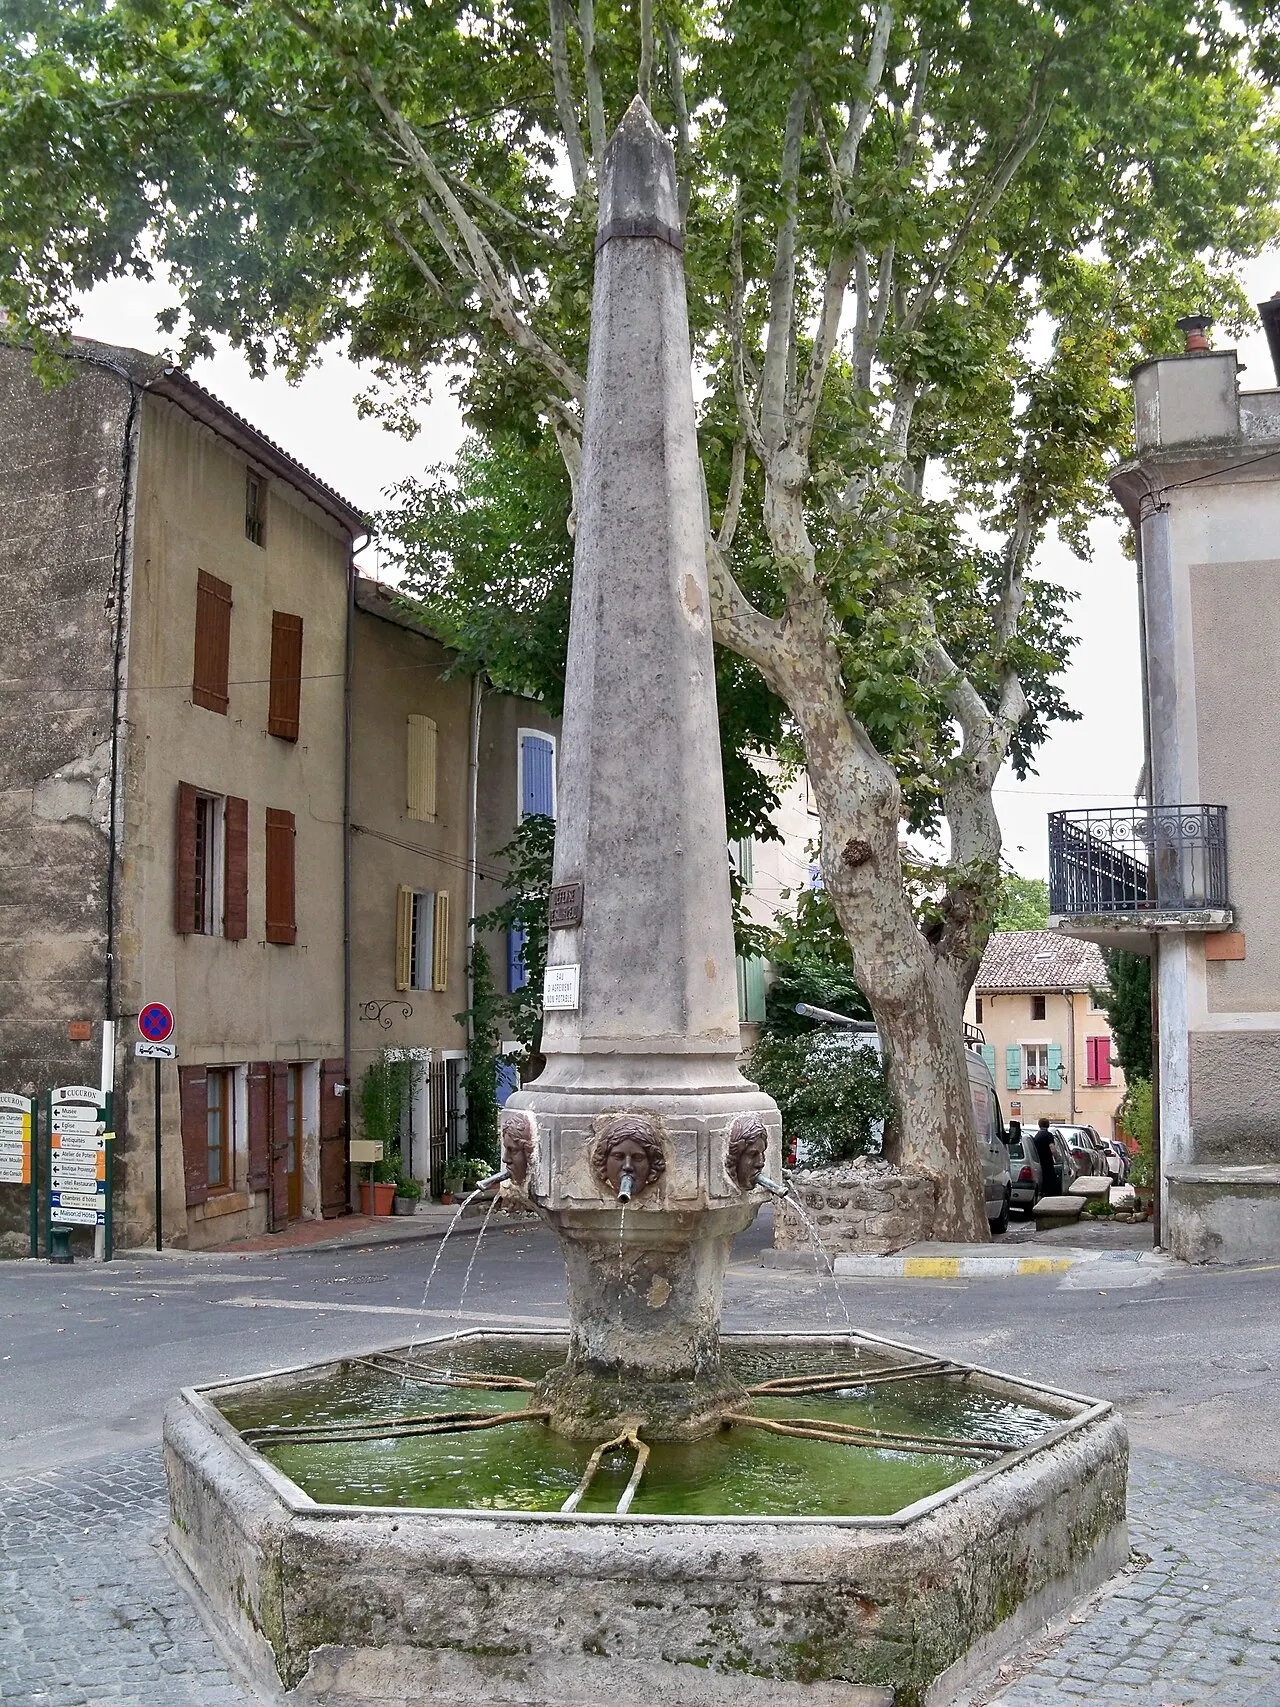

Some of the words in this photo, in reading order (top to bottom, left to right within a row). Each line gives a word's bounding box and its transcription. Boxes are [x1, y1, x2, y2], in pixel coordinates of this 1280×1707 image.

[67, 1090, 97, 1099] CUCURON
[0, 1096, 23, 1107] UCURON
[73, 1180, 96, 1188] Restaurant
